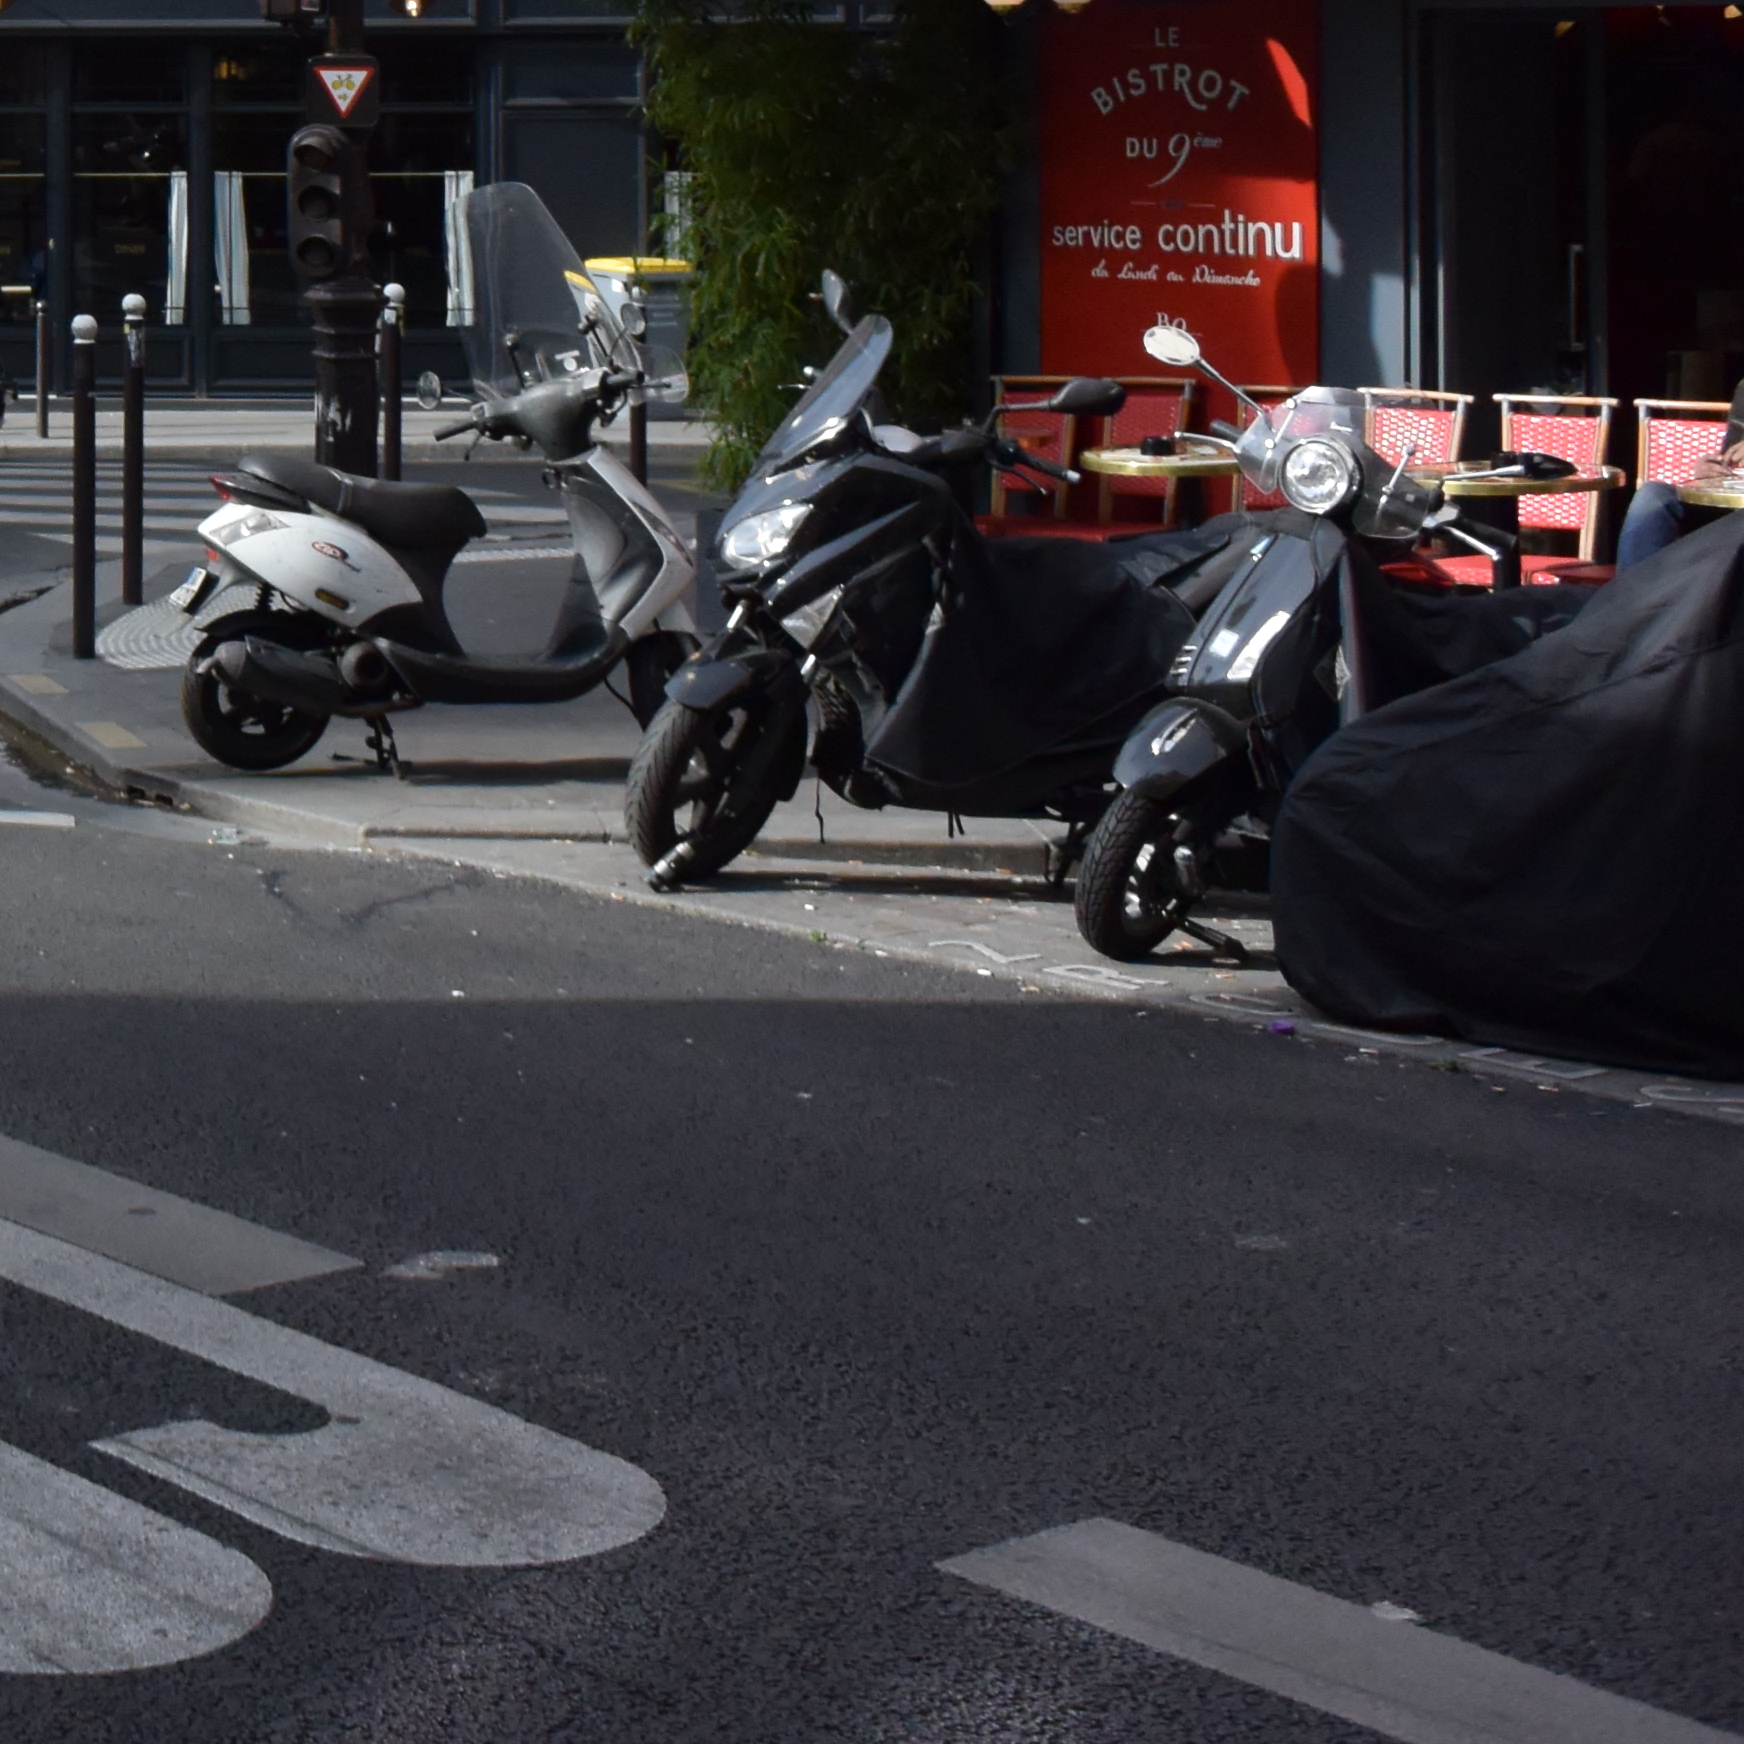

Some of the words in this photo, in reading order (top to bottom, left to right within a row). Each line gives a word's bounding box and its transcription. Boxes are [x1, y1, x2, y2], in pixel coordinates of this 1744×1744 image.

[1153, 27, 1180, 47] LE
[1090, 62, 1251, 116] BISTROT
[1125, 137, 1158, 158] DU
[1147, 131, 1223, 188] 9ème
[1052, 219, 1142, 251] service
[1158, 208, 1303, 261] continu
[1091, 258, 1110, 278] du
[1117, 262, 1158, 282] Lundi
[1166, 269, 1185, 283] au
[1191, 263, 1261, 288] Dimanche
